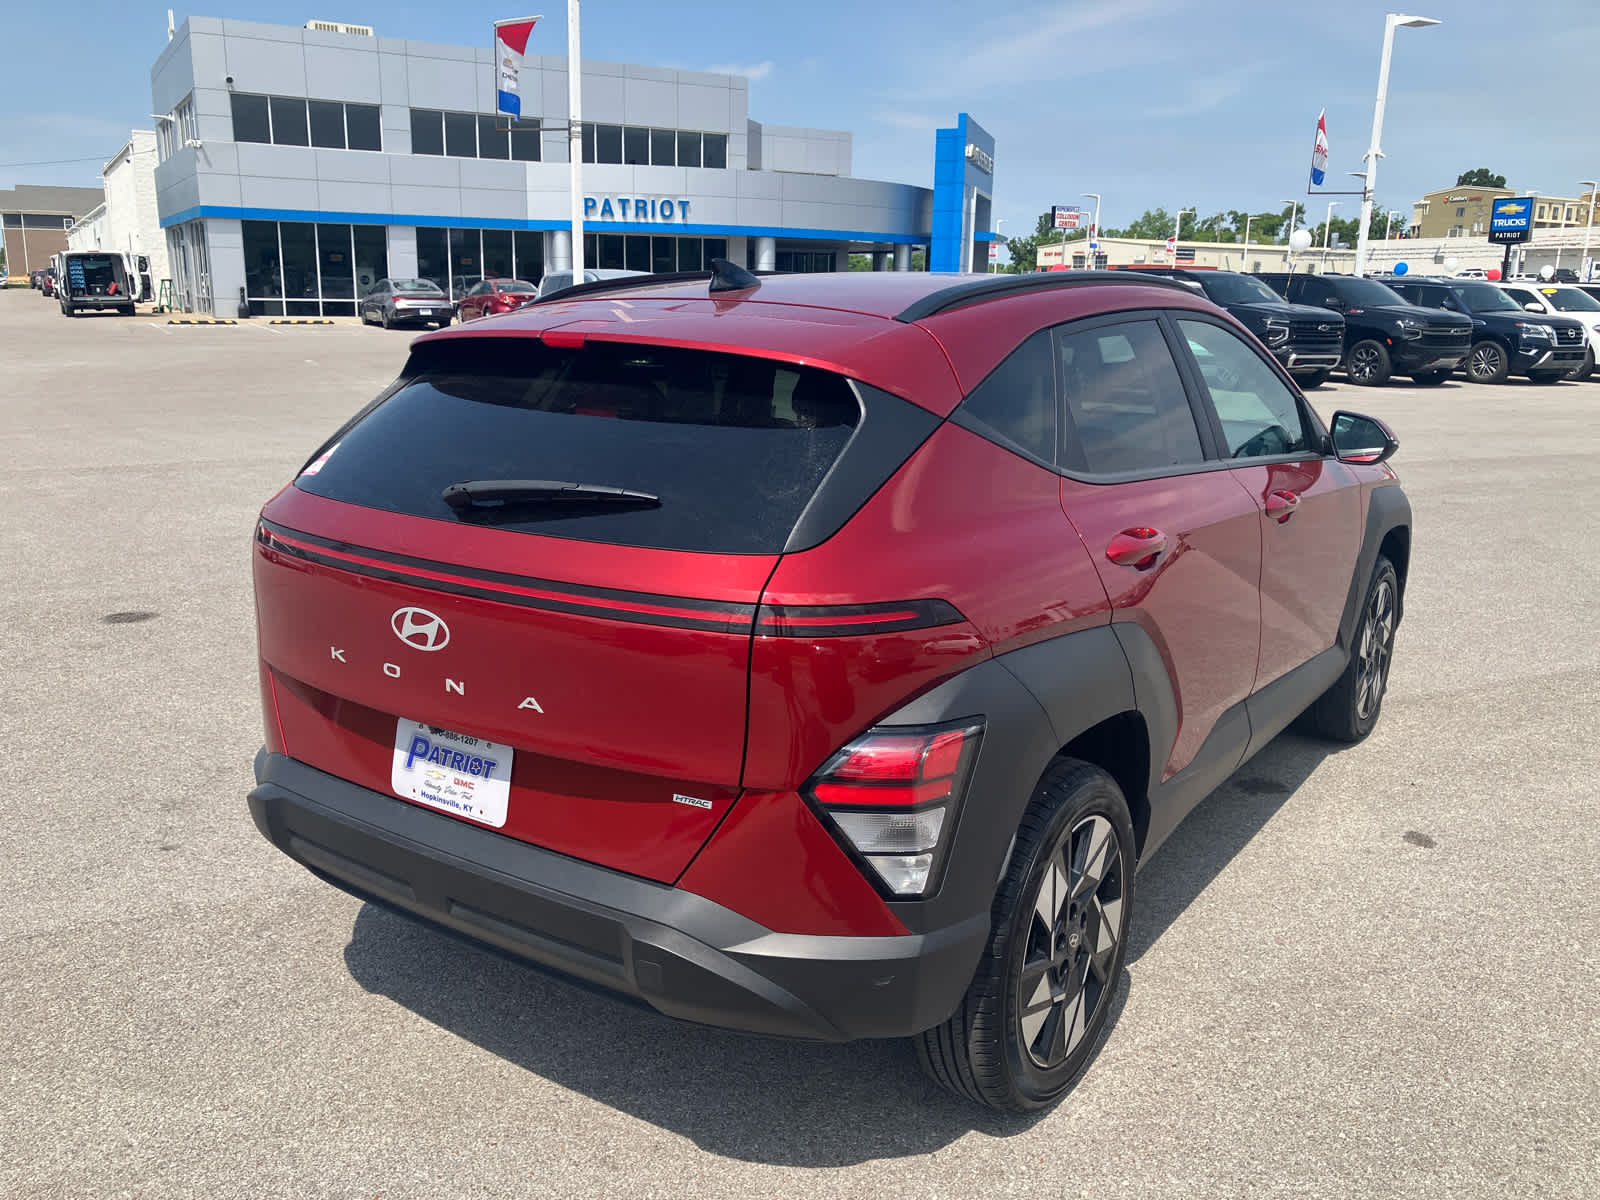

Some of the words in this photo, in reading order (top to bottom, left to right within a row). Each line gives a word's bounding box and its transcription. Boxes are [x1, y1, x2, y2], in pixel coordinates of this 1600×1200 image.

[583, 197, 690, 219] PATRIOT
[1493, 218, 1527, 228] TRUCKS
[330, 646, 545, 714] KONA
[453, 777, 475, 790] GMC
[421, 790, 462, 810] Hopkinsville,
[463, 803, 473, 813] KY
[675, 795, 710, 808] HTRAC
